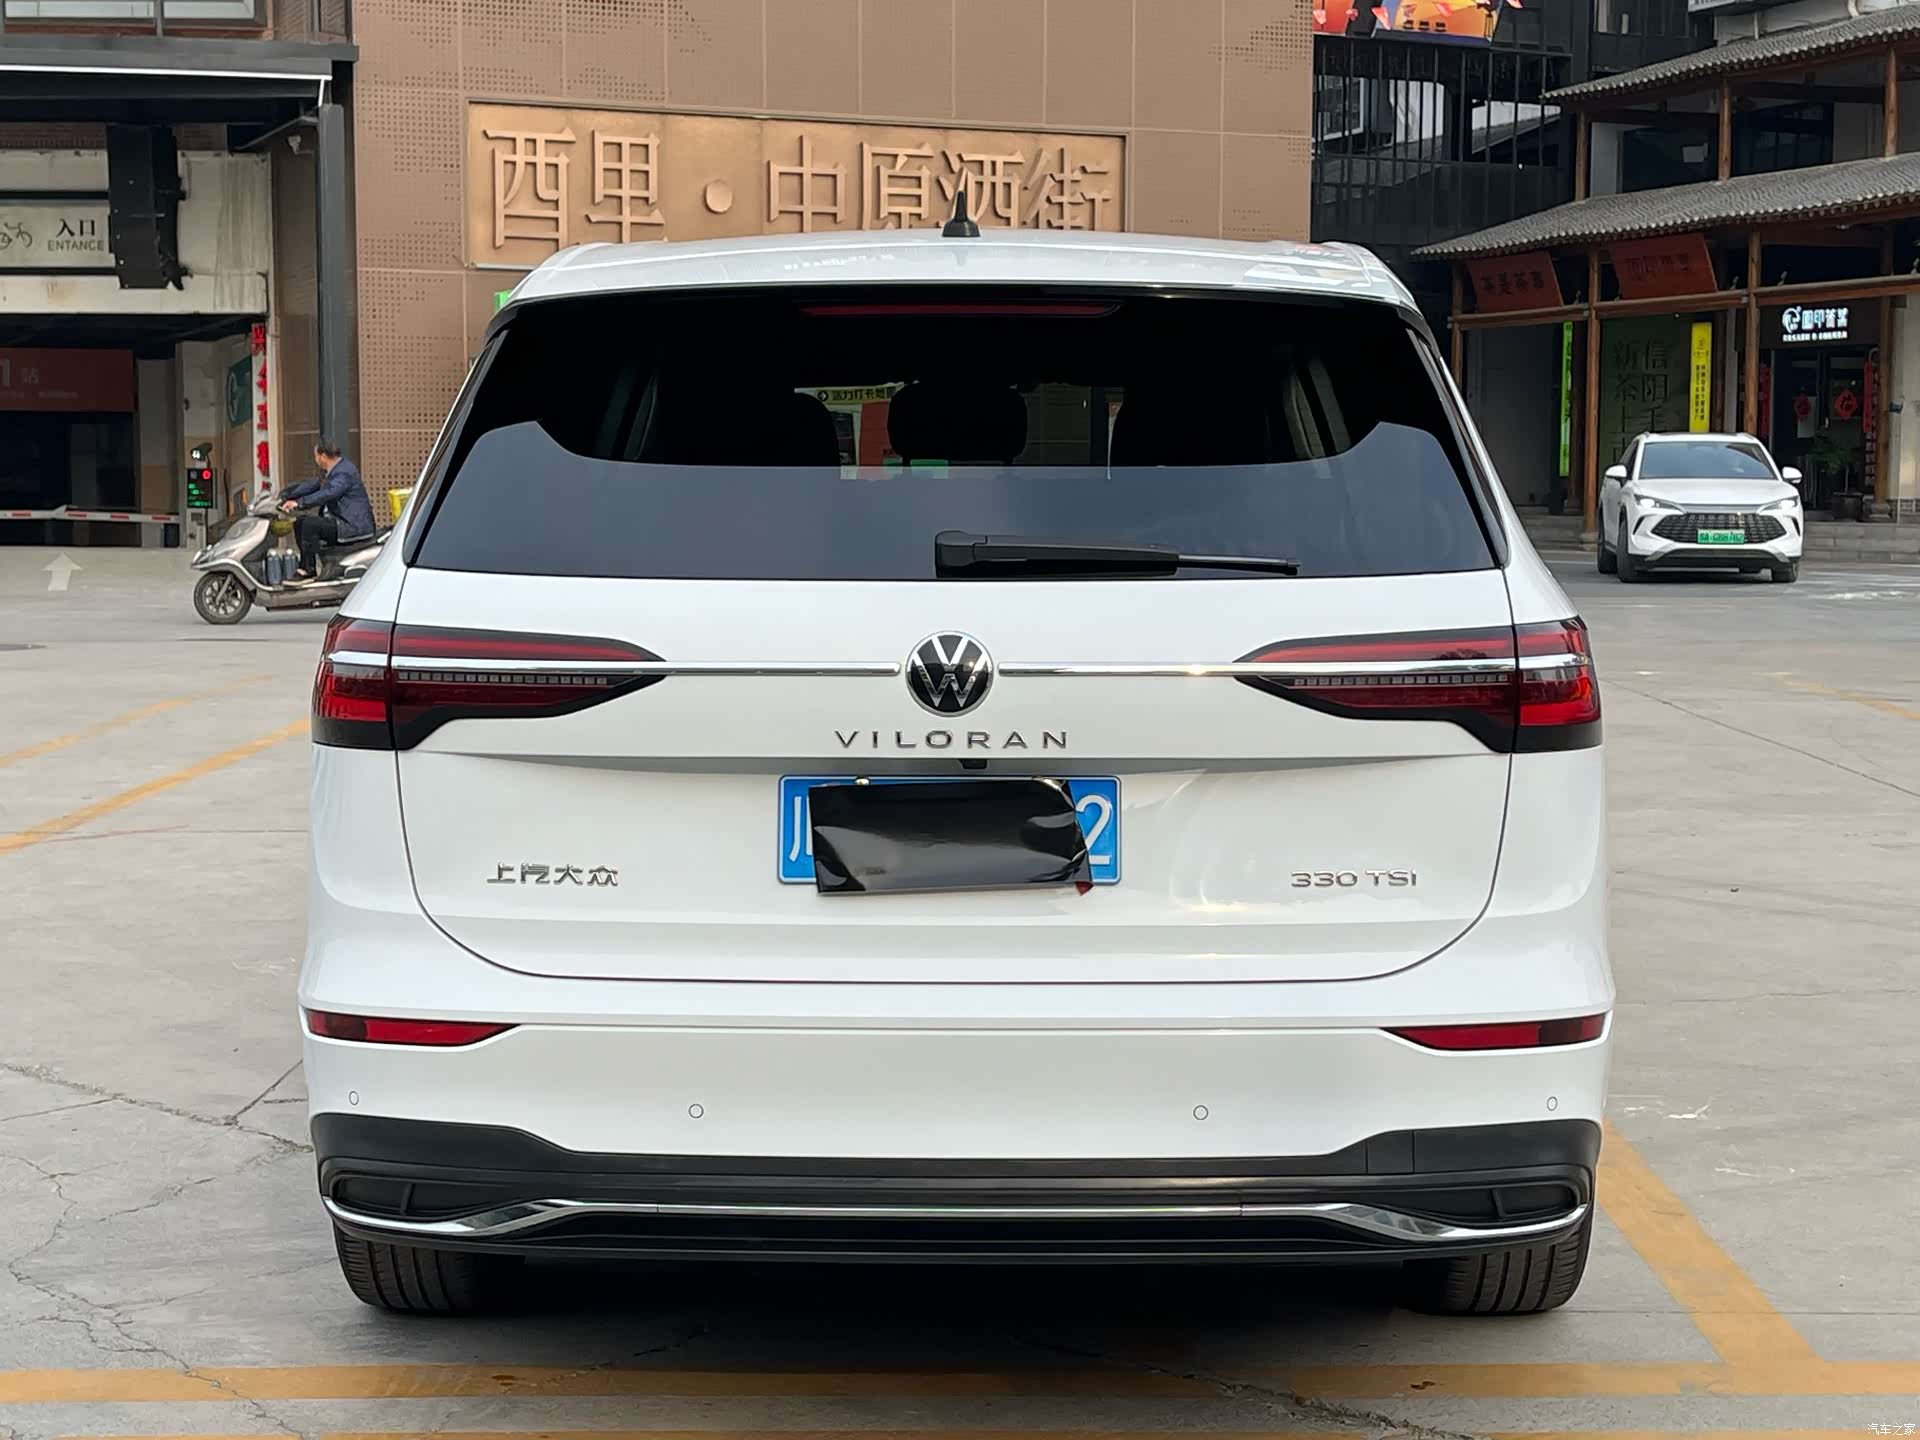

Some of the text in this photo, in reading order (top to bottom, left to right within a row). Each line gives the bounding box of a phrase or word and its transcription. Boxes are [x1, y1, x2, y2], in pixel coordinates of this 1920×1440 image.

[56, 218, 95, 238] 入口
[48, 239, 104, 252] ENTANCE
[834, 730, 1067, 749] VILORAN
[487, 862, 618, 886] 上汽大众
[1291, 869, 1417, 888] 330 TSI
